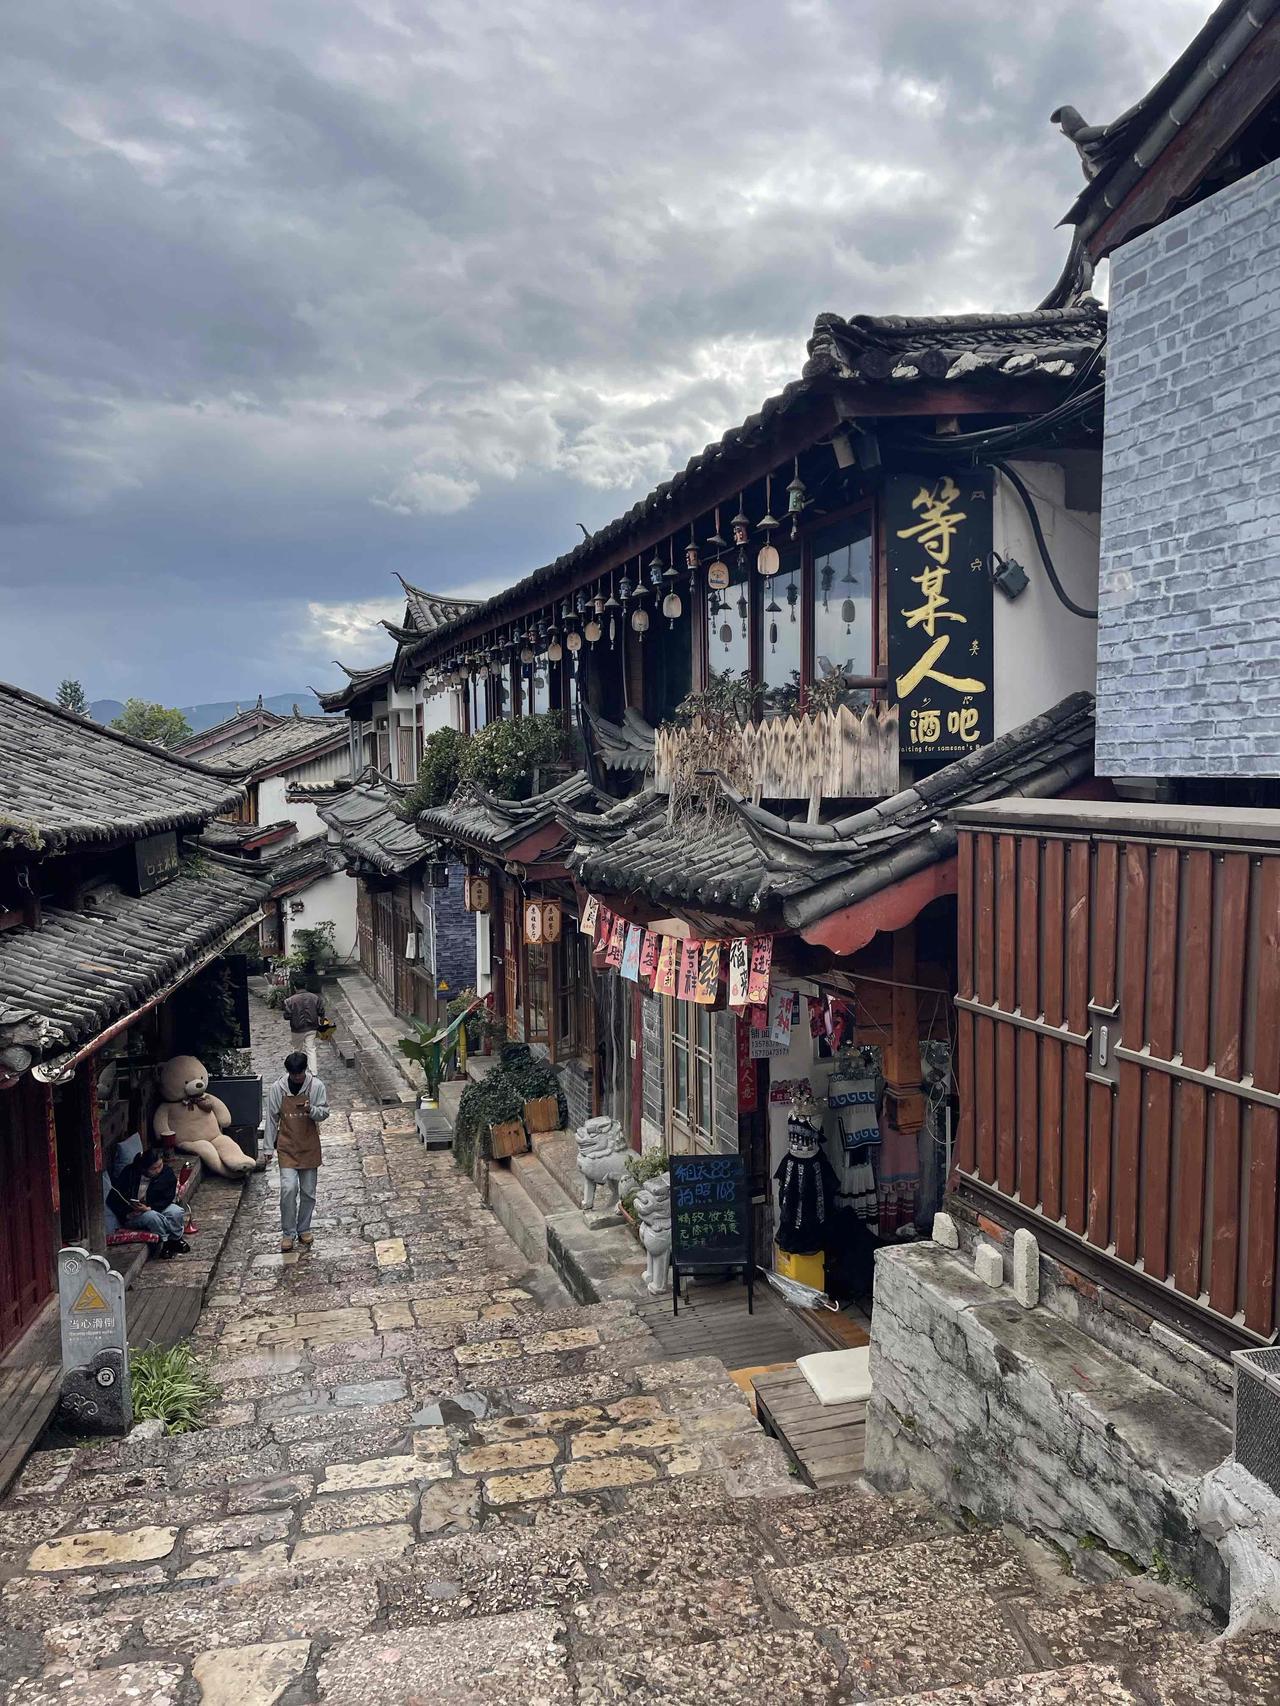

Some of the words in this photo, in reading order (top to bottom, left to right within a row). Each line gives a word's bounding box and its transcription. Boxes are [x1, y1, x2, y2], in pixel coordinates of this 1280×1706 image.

[896, 475, 987, 699] 等某人
[908, 707, 981, 744] 酒吧
[899, 745, 922, 753] aiting
[69, 1317, 115, 1330] 当心滑倒
